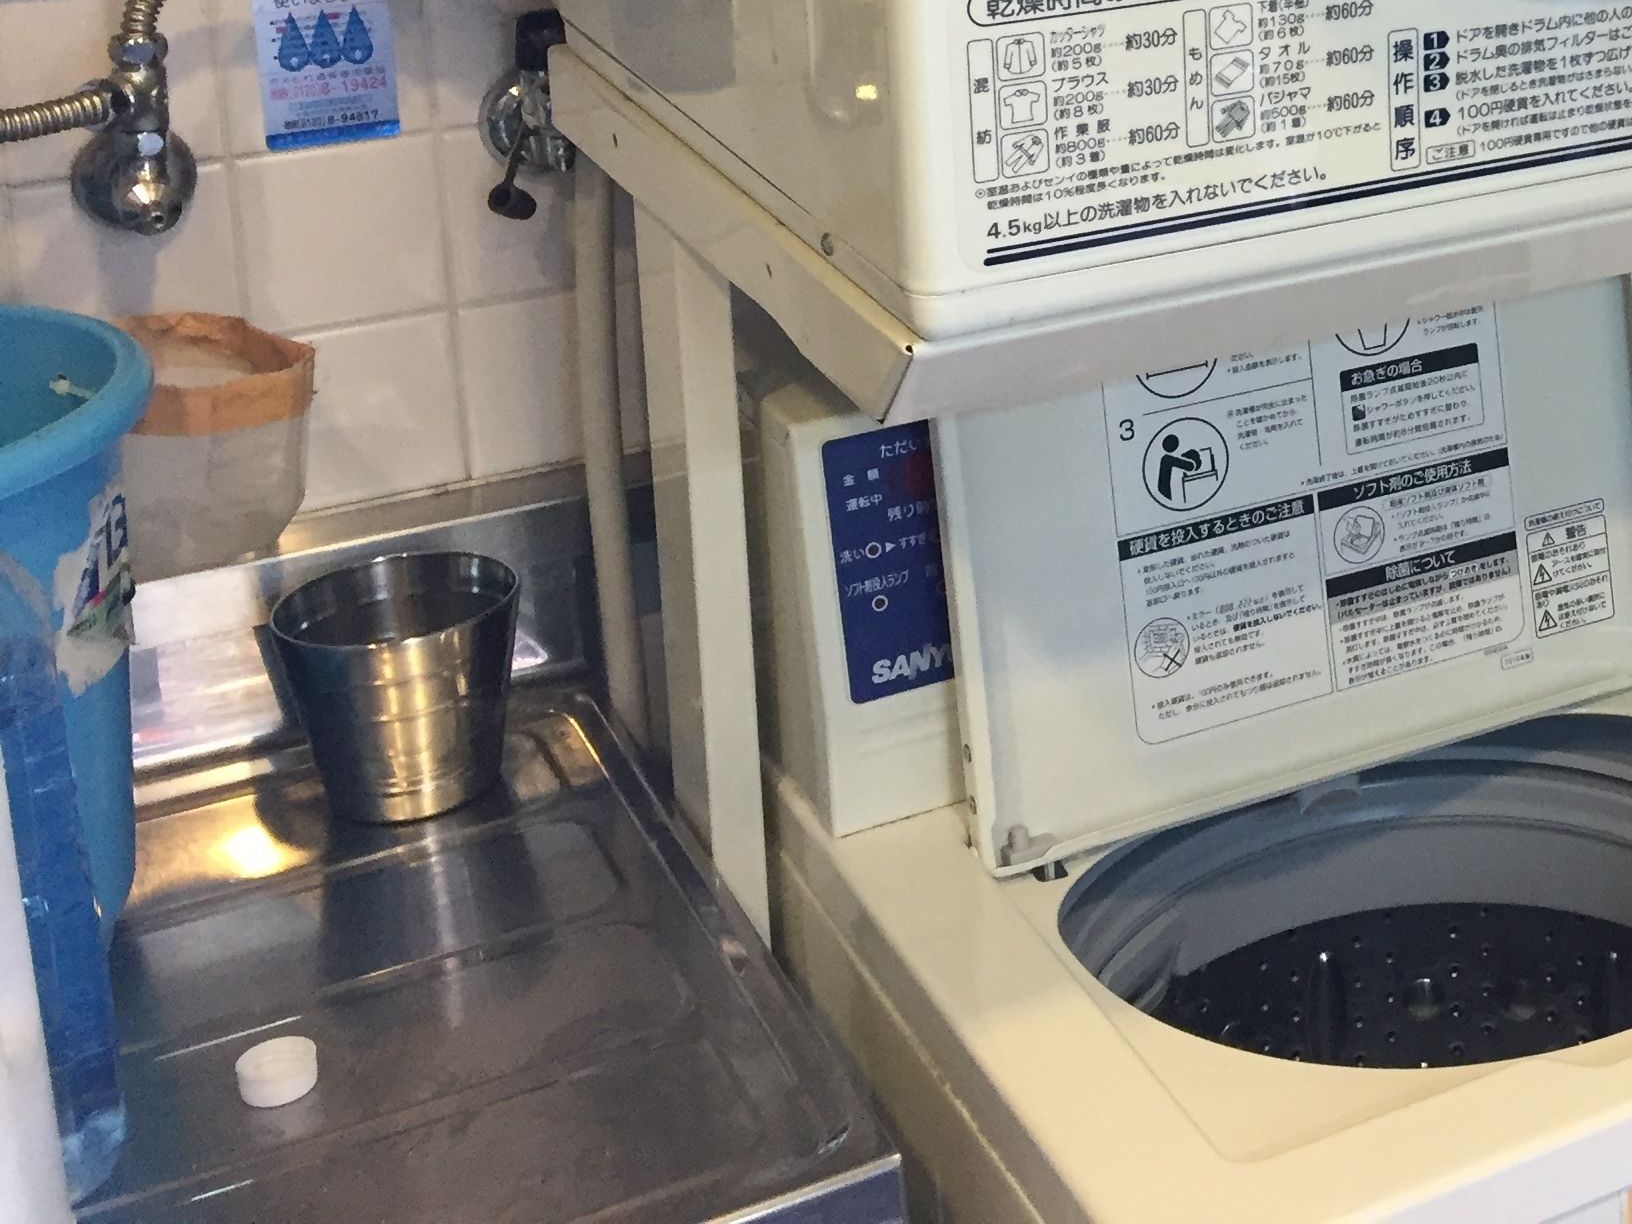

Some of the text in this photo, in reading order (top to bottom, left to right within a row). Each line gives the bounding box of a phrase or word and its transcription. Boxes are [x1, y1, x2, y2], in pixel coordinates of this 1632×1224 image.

[1258, 0, 1374, 28] 約130g 約60分
[1051, 28, 1178, 58] 約200g 約30分
[1259, 42, 1310, 60] タオル
[1260, 44, 1374, 74] 約70g 約60分
[1052, 72, 1108, 92] ブラウス
[1053, 75, 1179, 107] 約200g 約30分
[1189, 48, 1203, 110] もめん
[1261, 87, 1312, 106] パジャマ
[1261, 90, 1375, 120] 約500g 約60分
[1393, 40, 1415, 161] 操作順序
[1054, 119, 1111, 140] 作業服
[1055, 121, 1180, 154] 約800g 約60分
[1431, 144, 1469, 161] ご注意
[987, 168, 1327, 239] 4.5kg以上の洗濯物を入れないでください。
[1350, 360, 1423, 386] お急ぎの場合
[1119, 419, 1135, 441] 3
[1354, 461, 1472, 500] ソフト剤のご使用方法
[846, 494, 882, 511] 運転中
[1129, 499, 1304, 555] 硬貨を投入するときのご注意
[1566, 525, 1586, 539] 警告
[840, 548, 863, 563] 洗い
[1385, 549, 1456, 580] 除菌について
[872, 643, 953, 684] SANY
